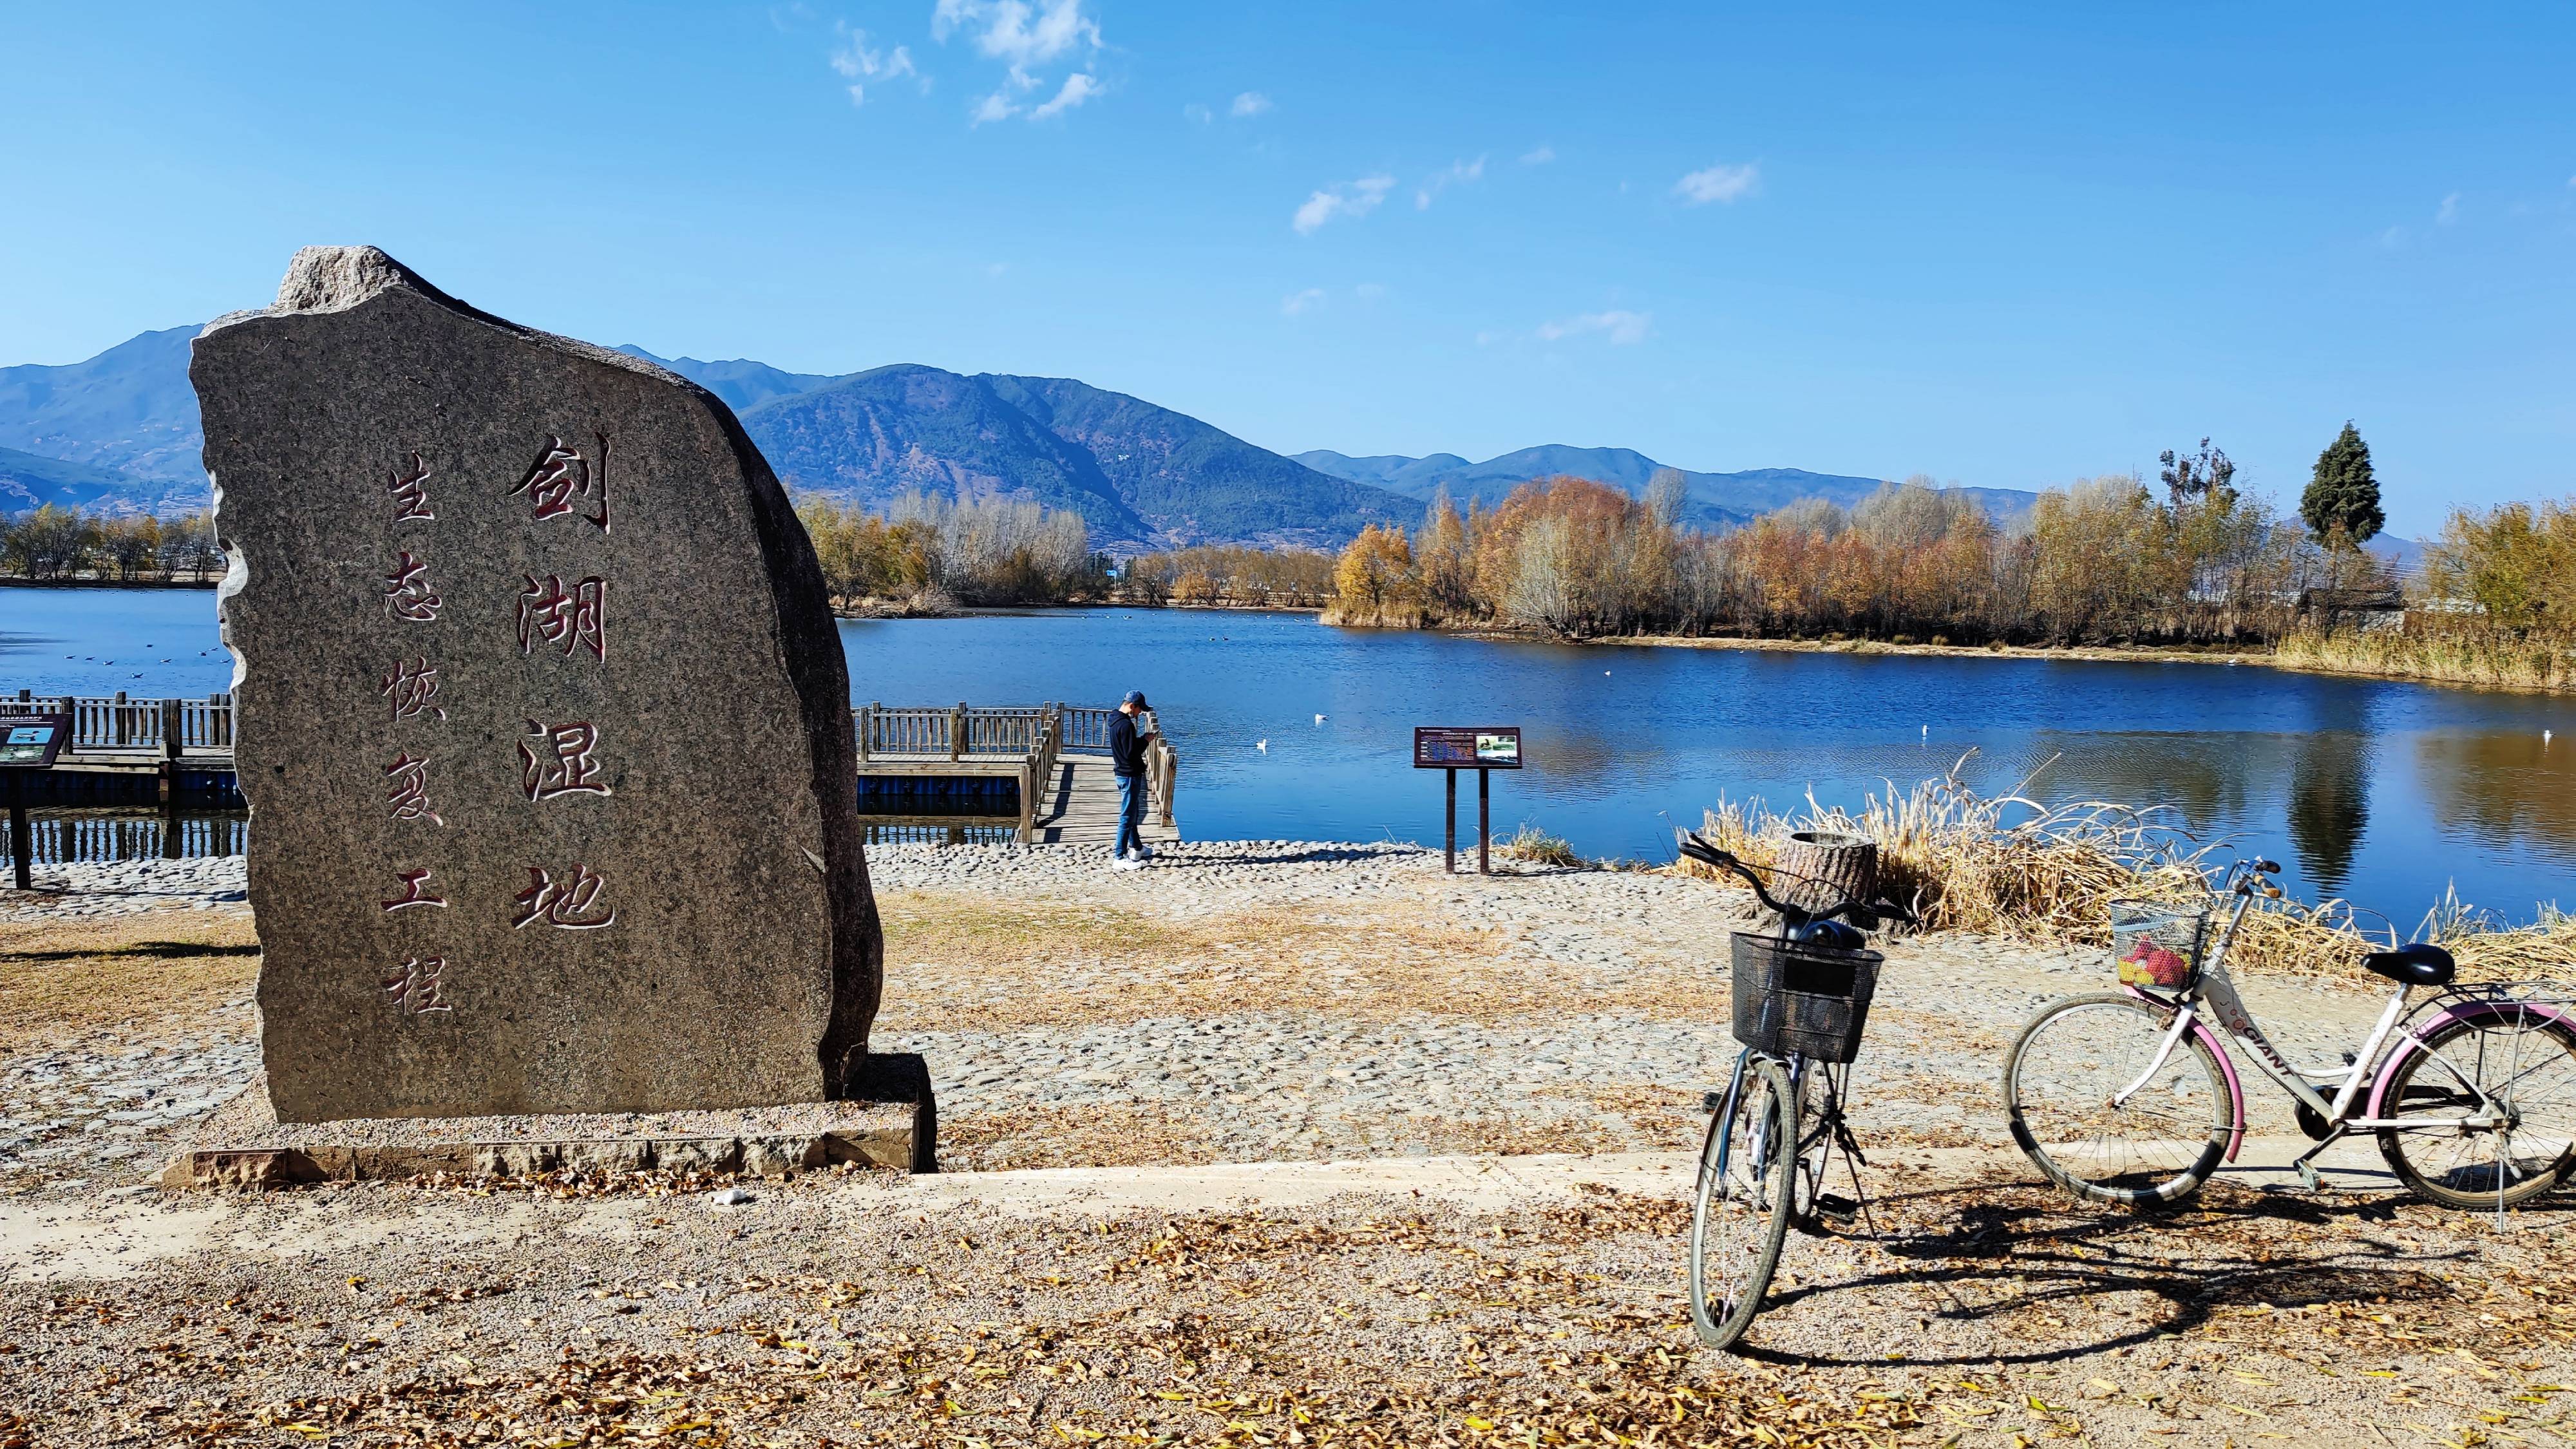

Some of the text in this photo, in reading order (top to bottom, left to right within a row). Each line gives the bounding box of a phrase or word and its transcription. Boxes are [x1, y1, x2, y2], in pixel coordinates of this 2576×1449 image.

[381, 450, 452, 1016] 生态恢复工程
[507, 431, 616, 930] 剑湖湿地
[2242, 1027, 2295, 1077] GIANT
